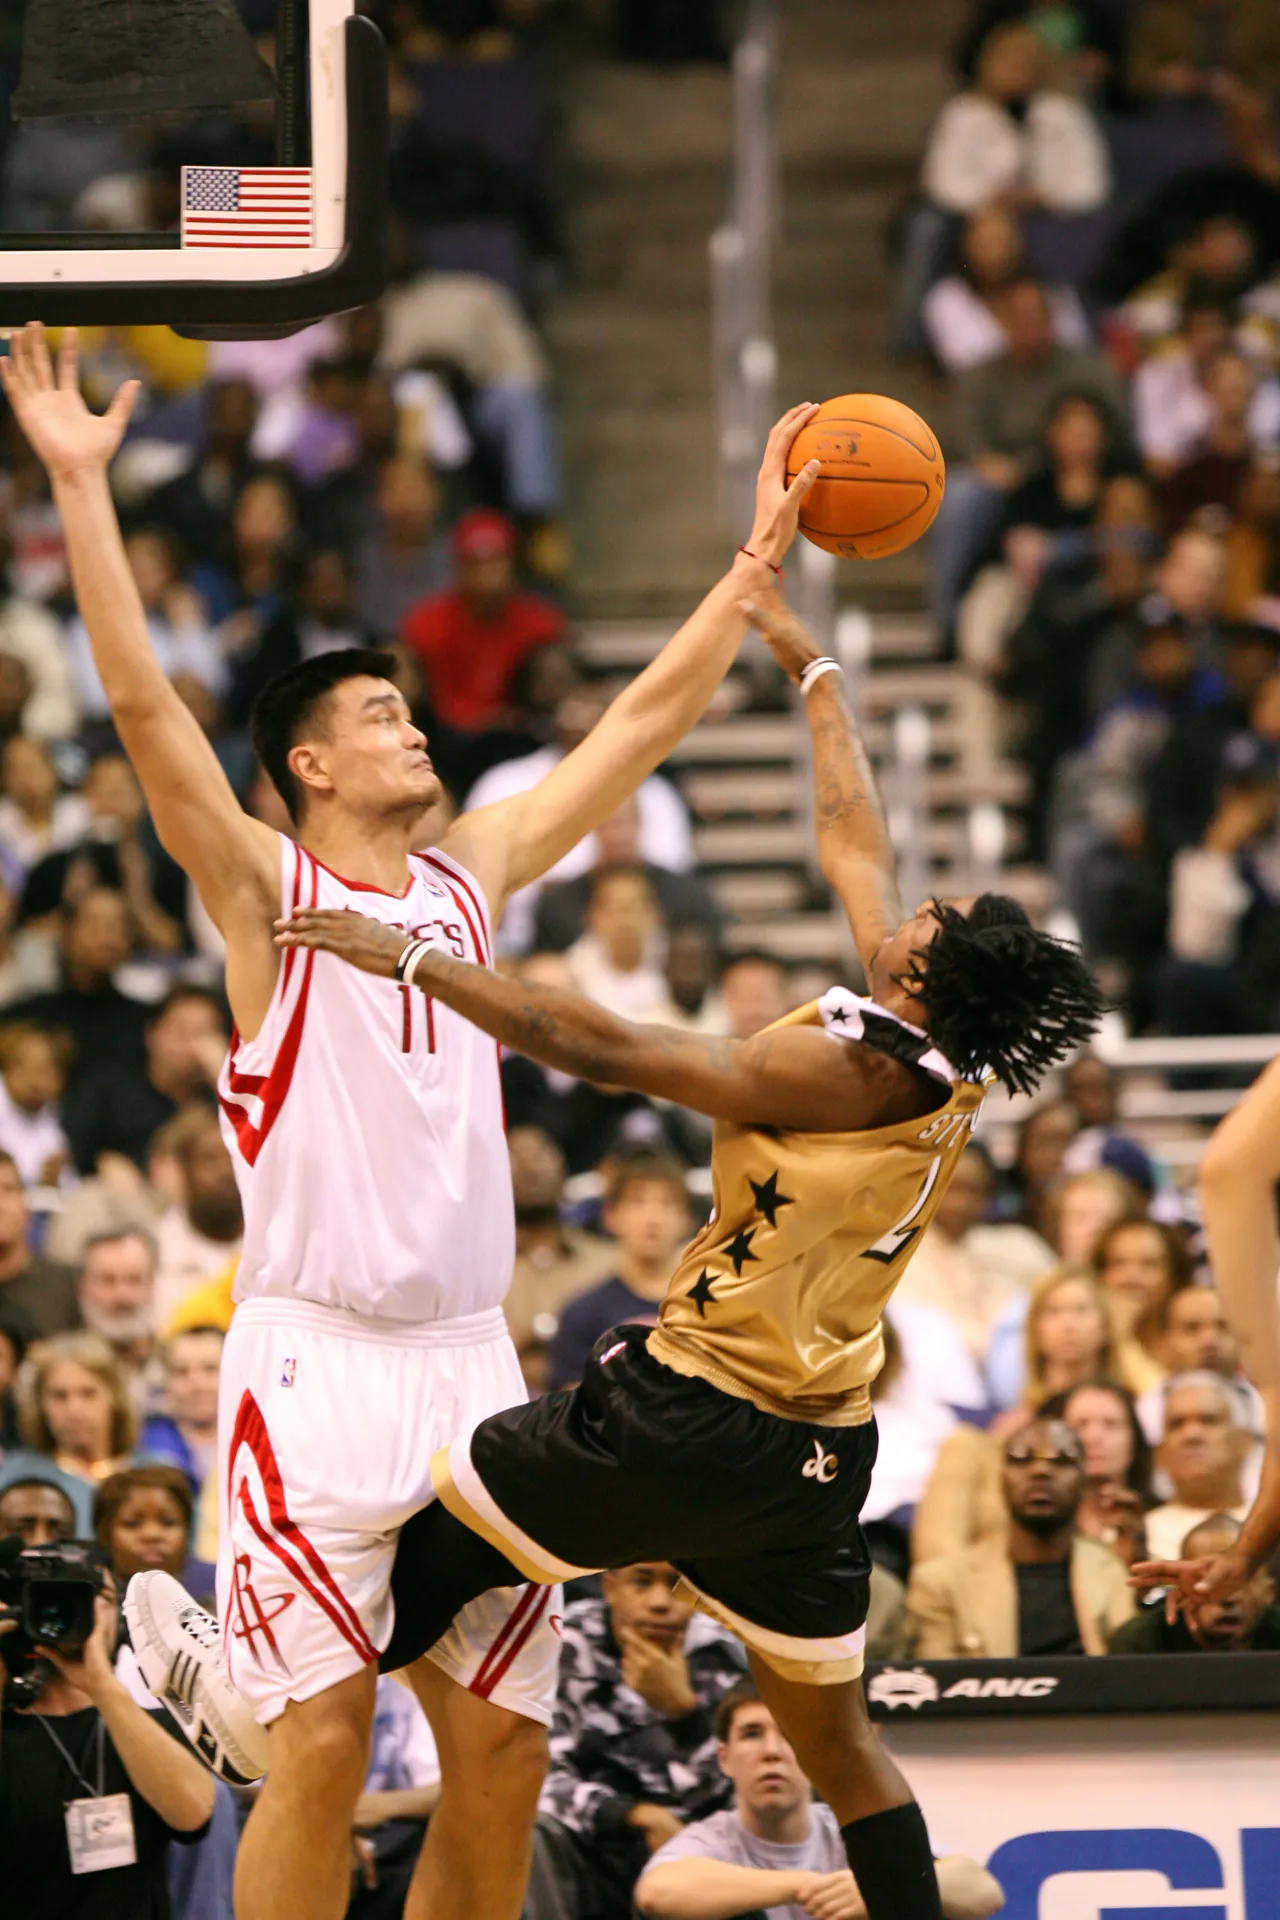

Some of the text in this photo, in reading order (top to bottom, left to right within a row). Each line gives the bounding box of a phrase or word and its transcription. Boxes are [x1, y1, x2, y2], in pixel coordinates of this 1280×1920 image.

[397, 985, 436, 1054] 11
[942, 1677, 1059, 1698] ANC
[985, 1827, 1280, 1920] G
